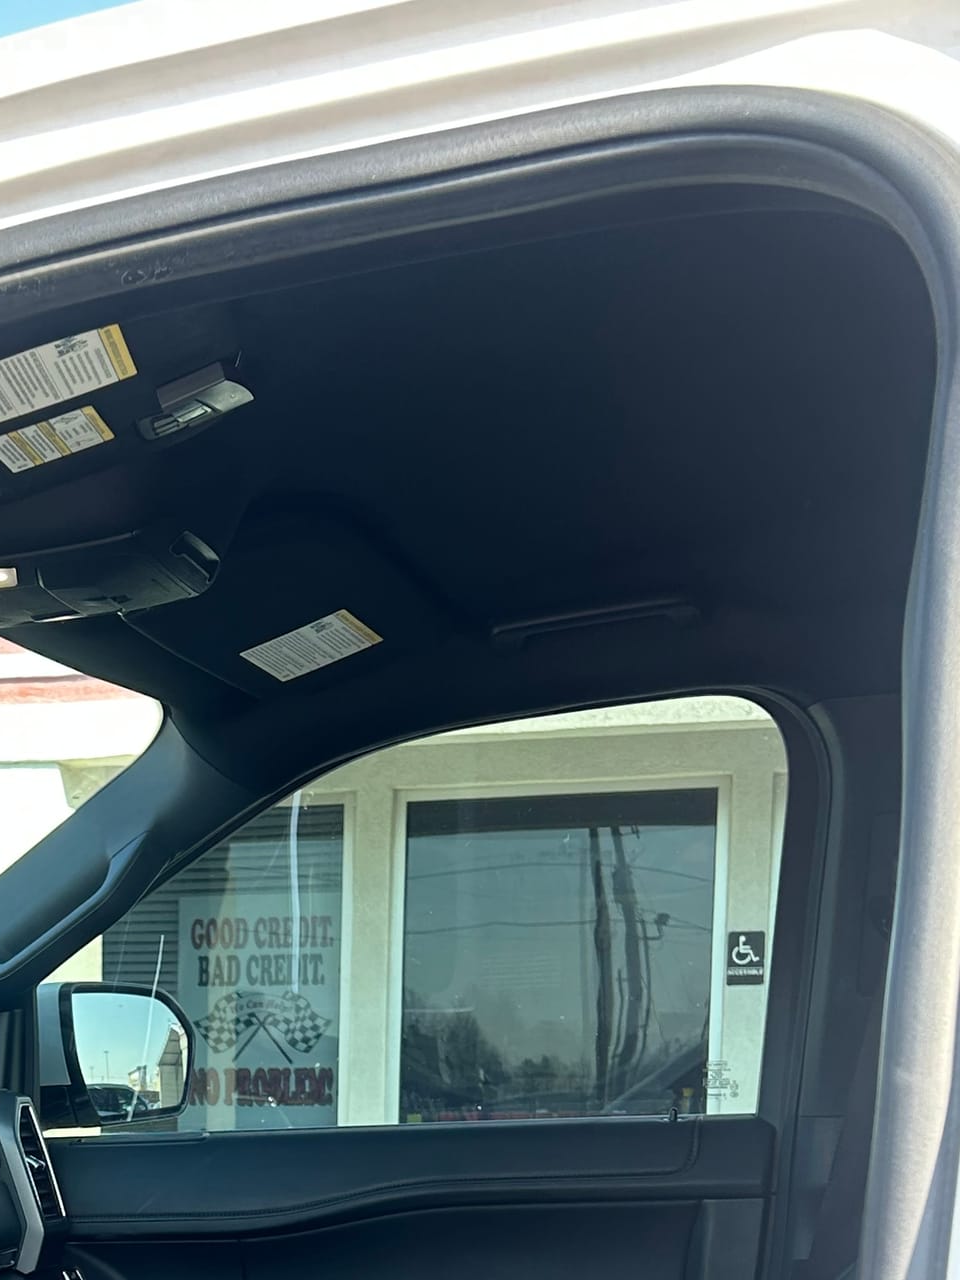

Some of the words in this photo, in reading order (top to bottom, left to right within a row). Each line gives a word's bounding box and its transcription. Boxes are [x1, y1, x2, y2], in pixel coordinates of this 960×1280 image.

[191, 918, 248, 950] GOOD
[197, 955, 240, 987] BAD
[190, 1067, 220, 1106] NO
